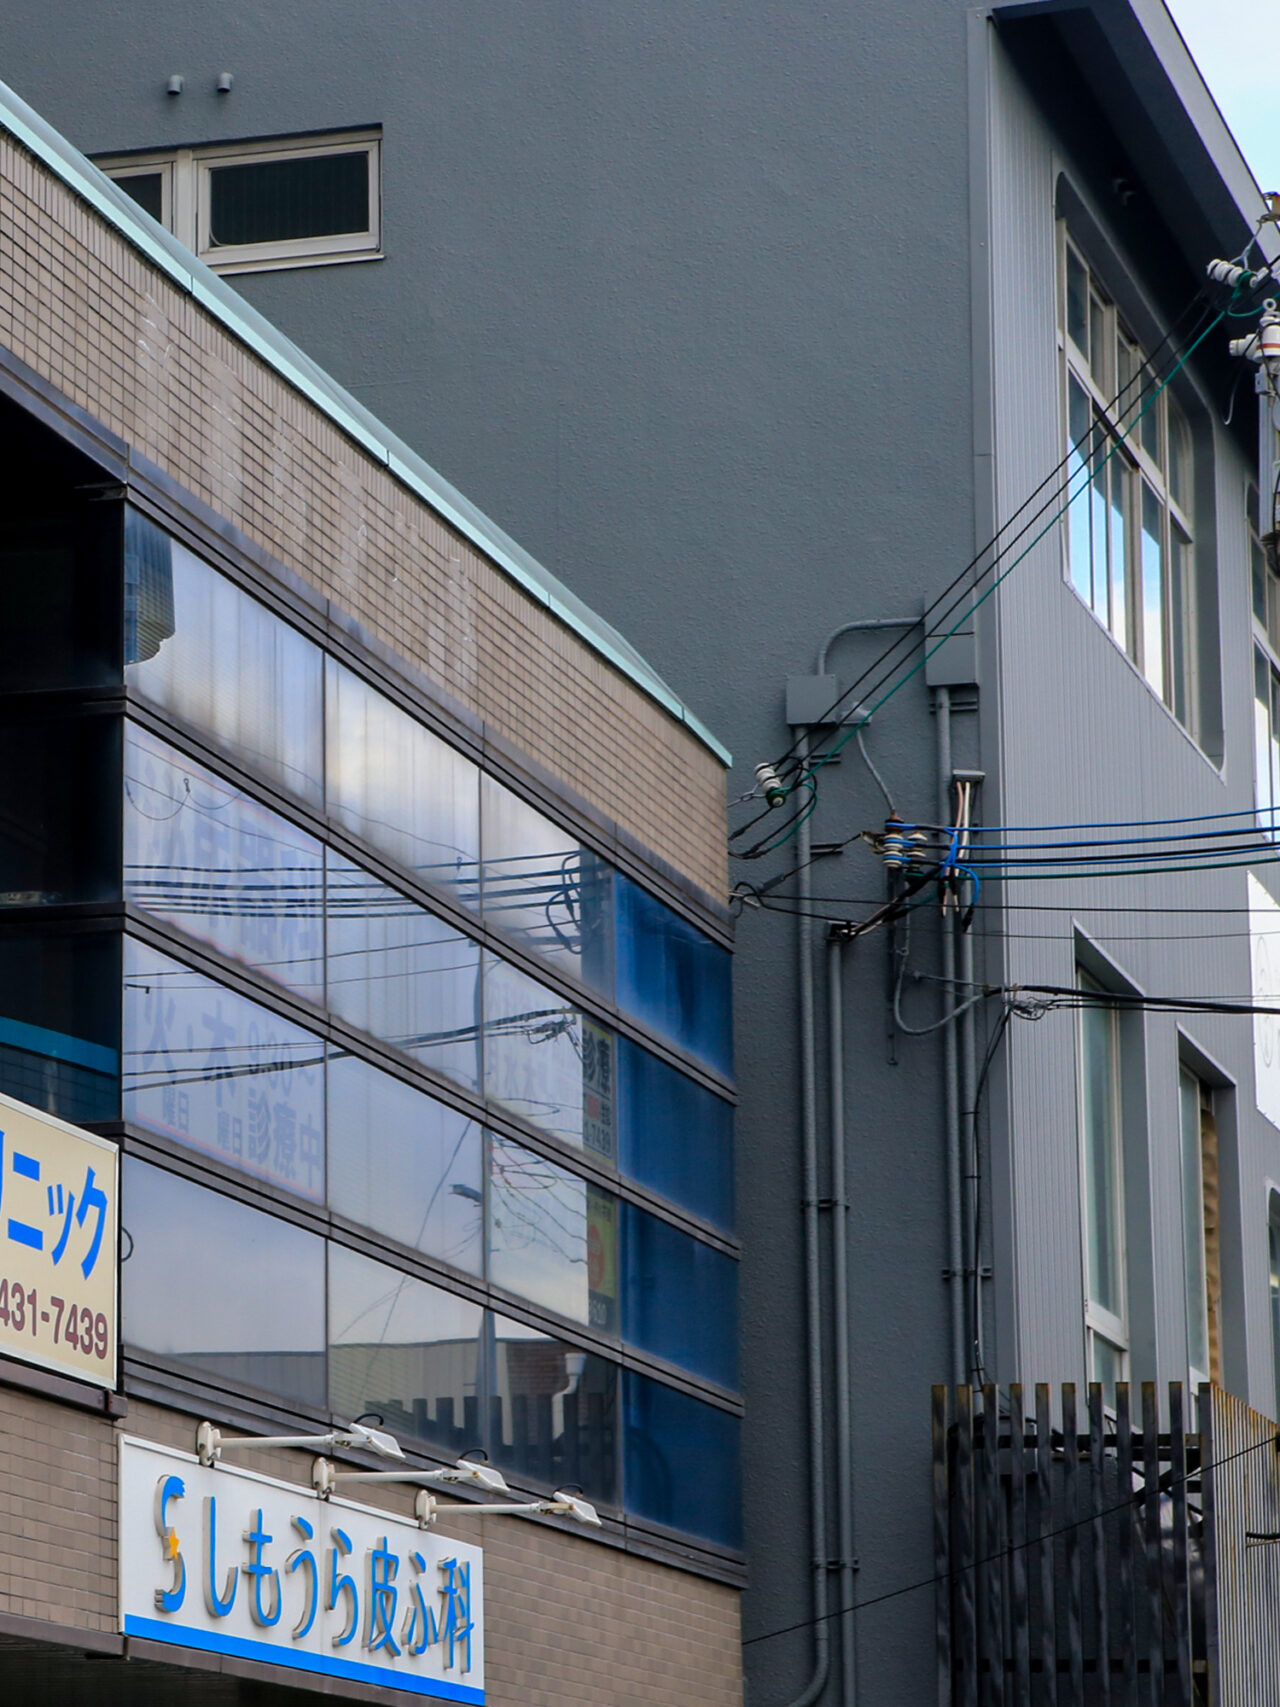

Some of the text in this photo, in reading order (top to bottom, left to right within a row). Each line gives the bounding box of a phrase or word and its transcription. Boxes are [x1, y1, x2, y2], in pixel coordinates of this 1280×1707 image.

[247, 1086, 321, 1189] 診療中
[203, 1496, 474, 1674] しもうら皮ふ科
